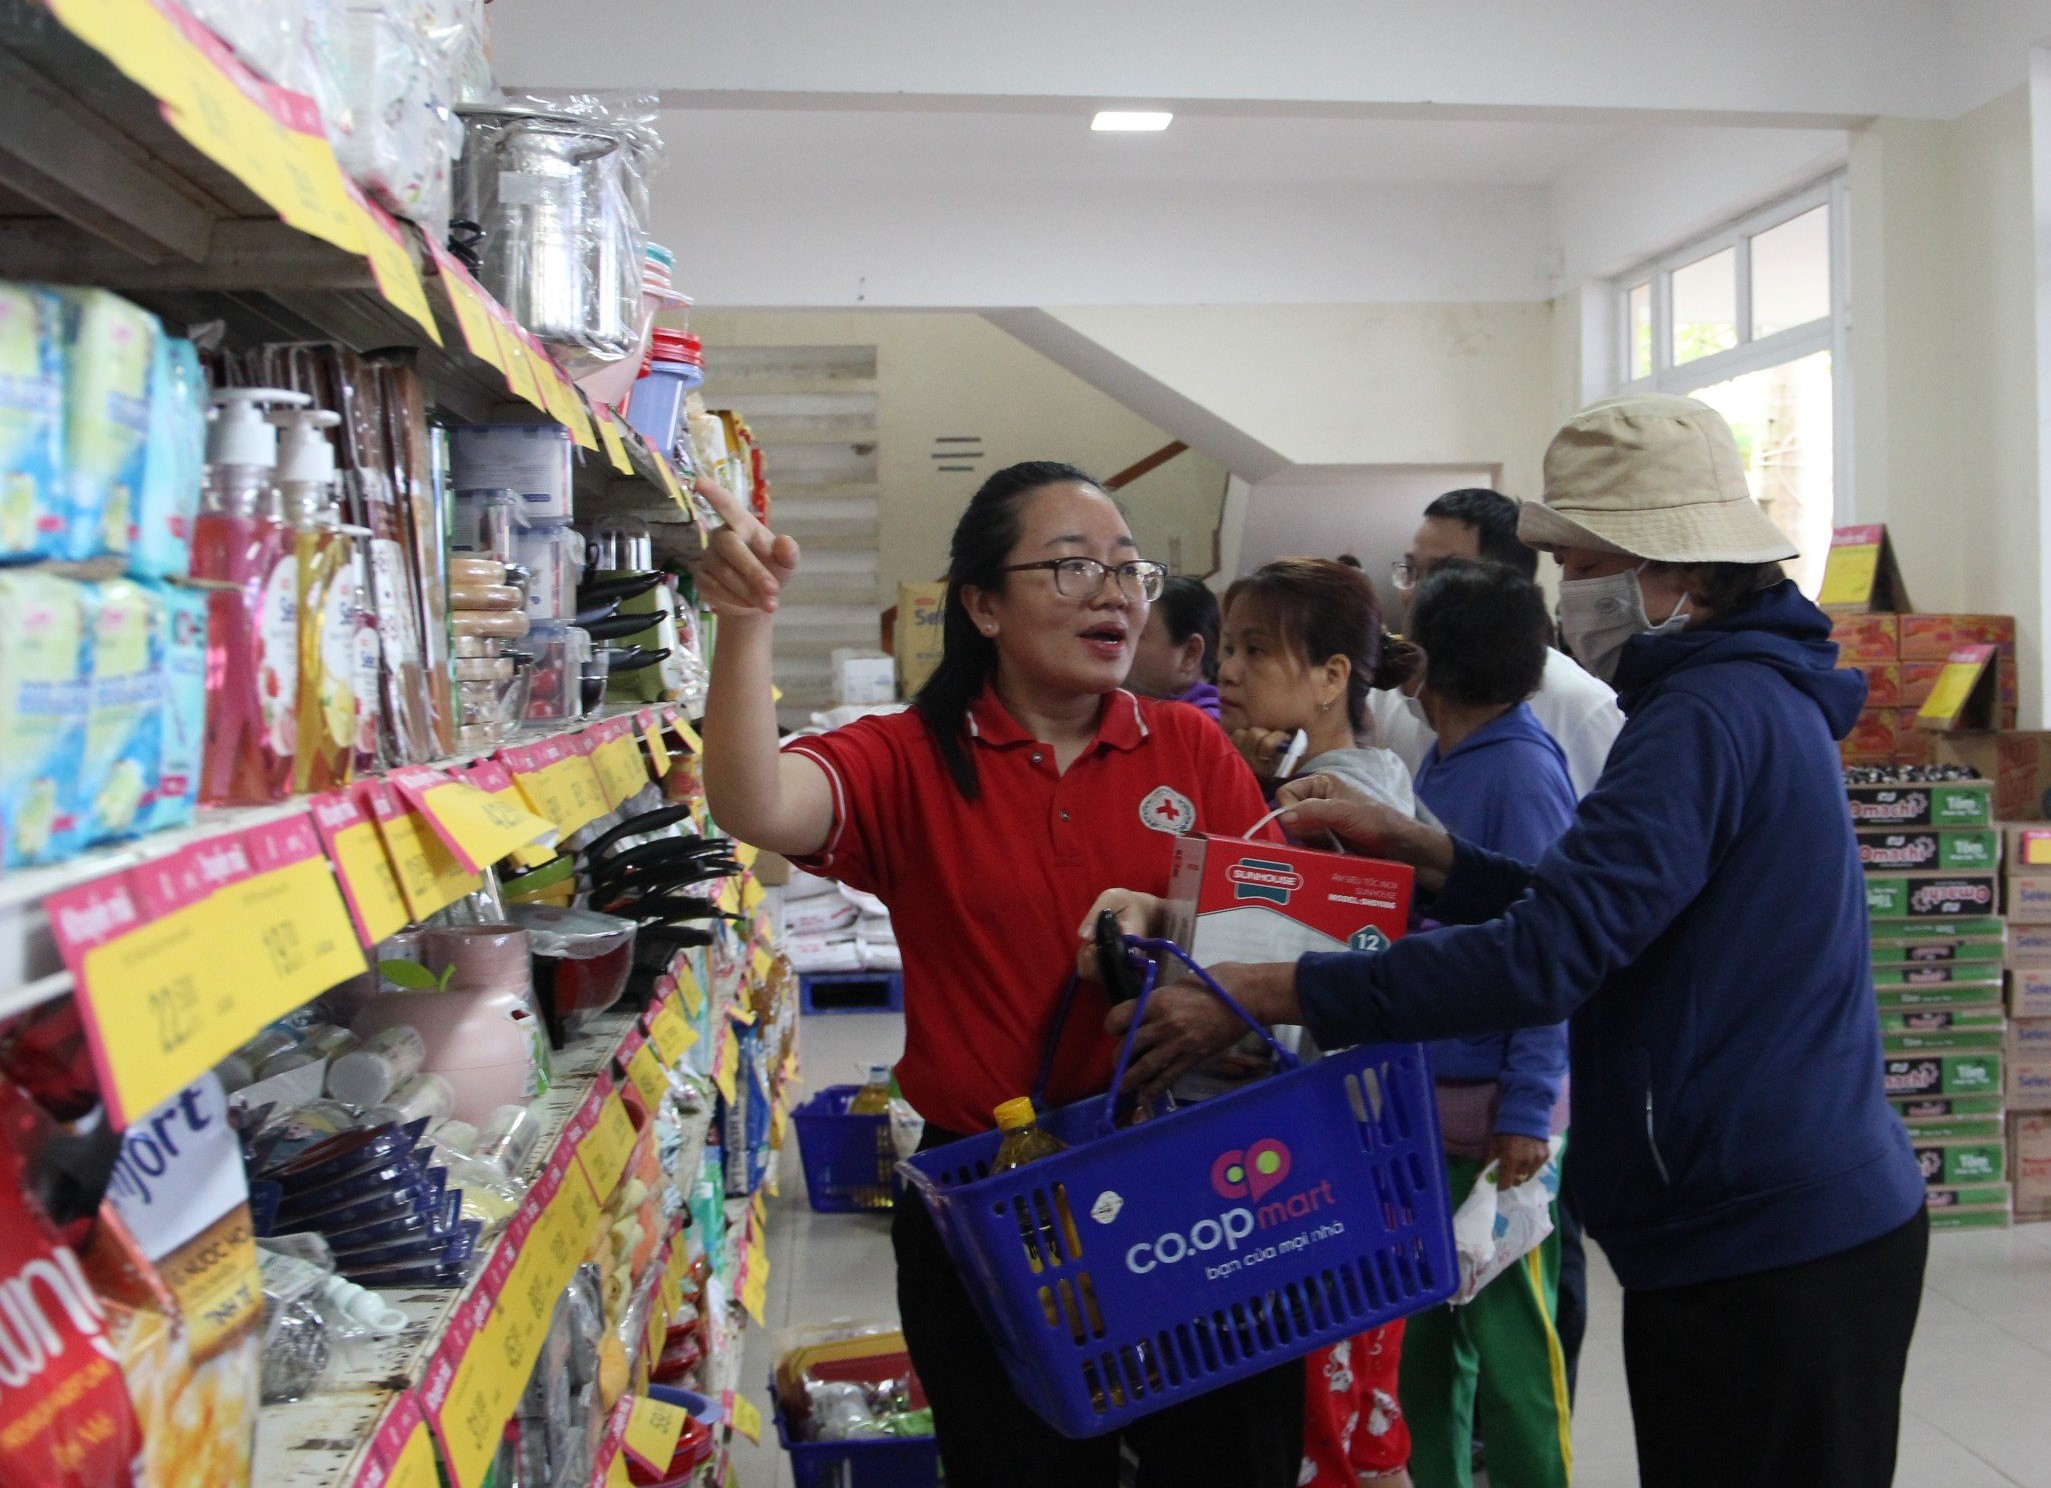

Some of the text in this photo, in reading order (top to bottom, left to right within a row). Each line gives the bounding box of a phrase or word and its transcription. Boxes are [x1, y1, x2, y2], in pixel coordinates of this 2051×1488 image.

[1233, 869, 1297, 886] SUNHOUSE
[1358, 933, 1380, 951] 12
[1205, 1220, 1345, 1281] bạn của mọi nhà
